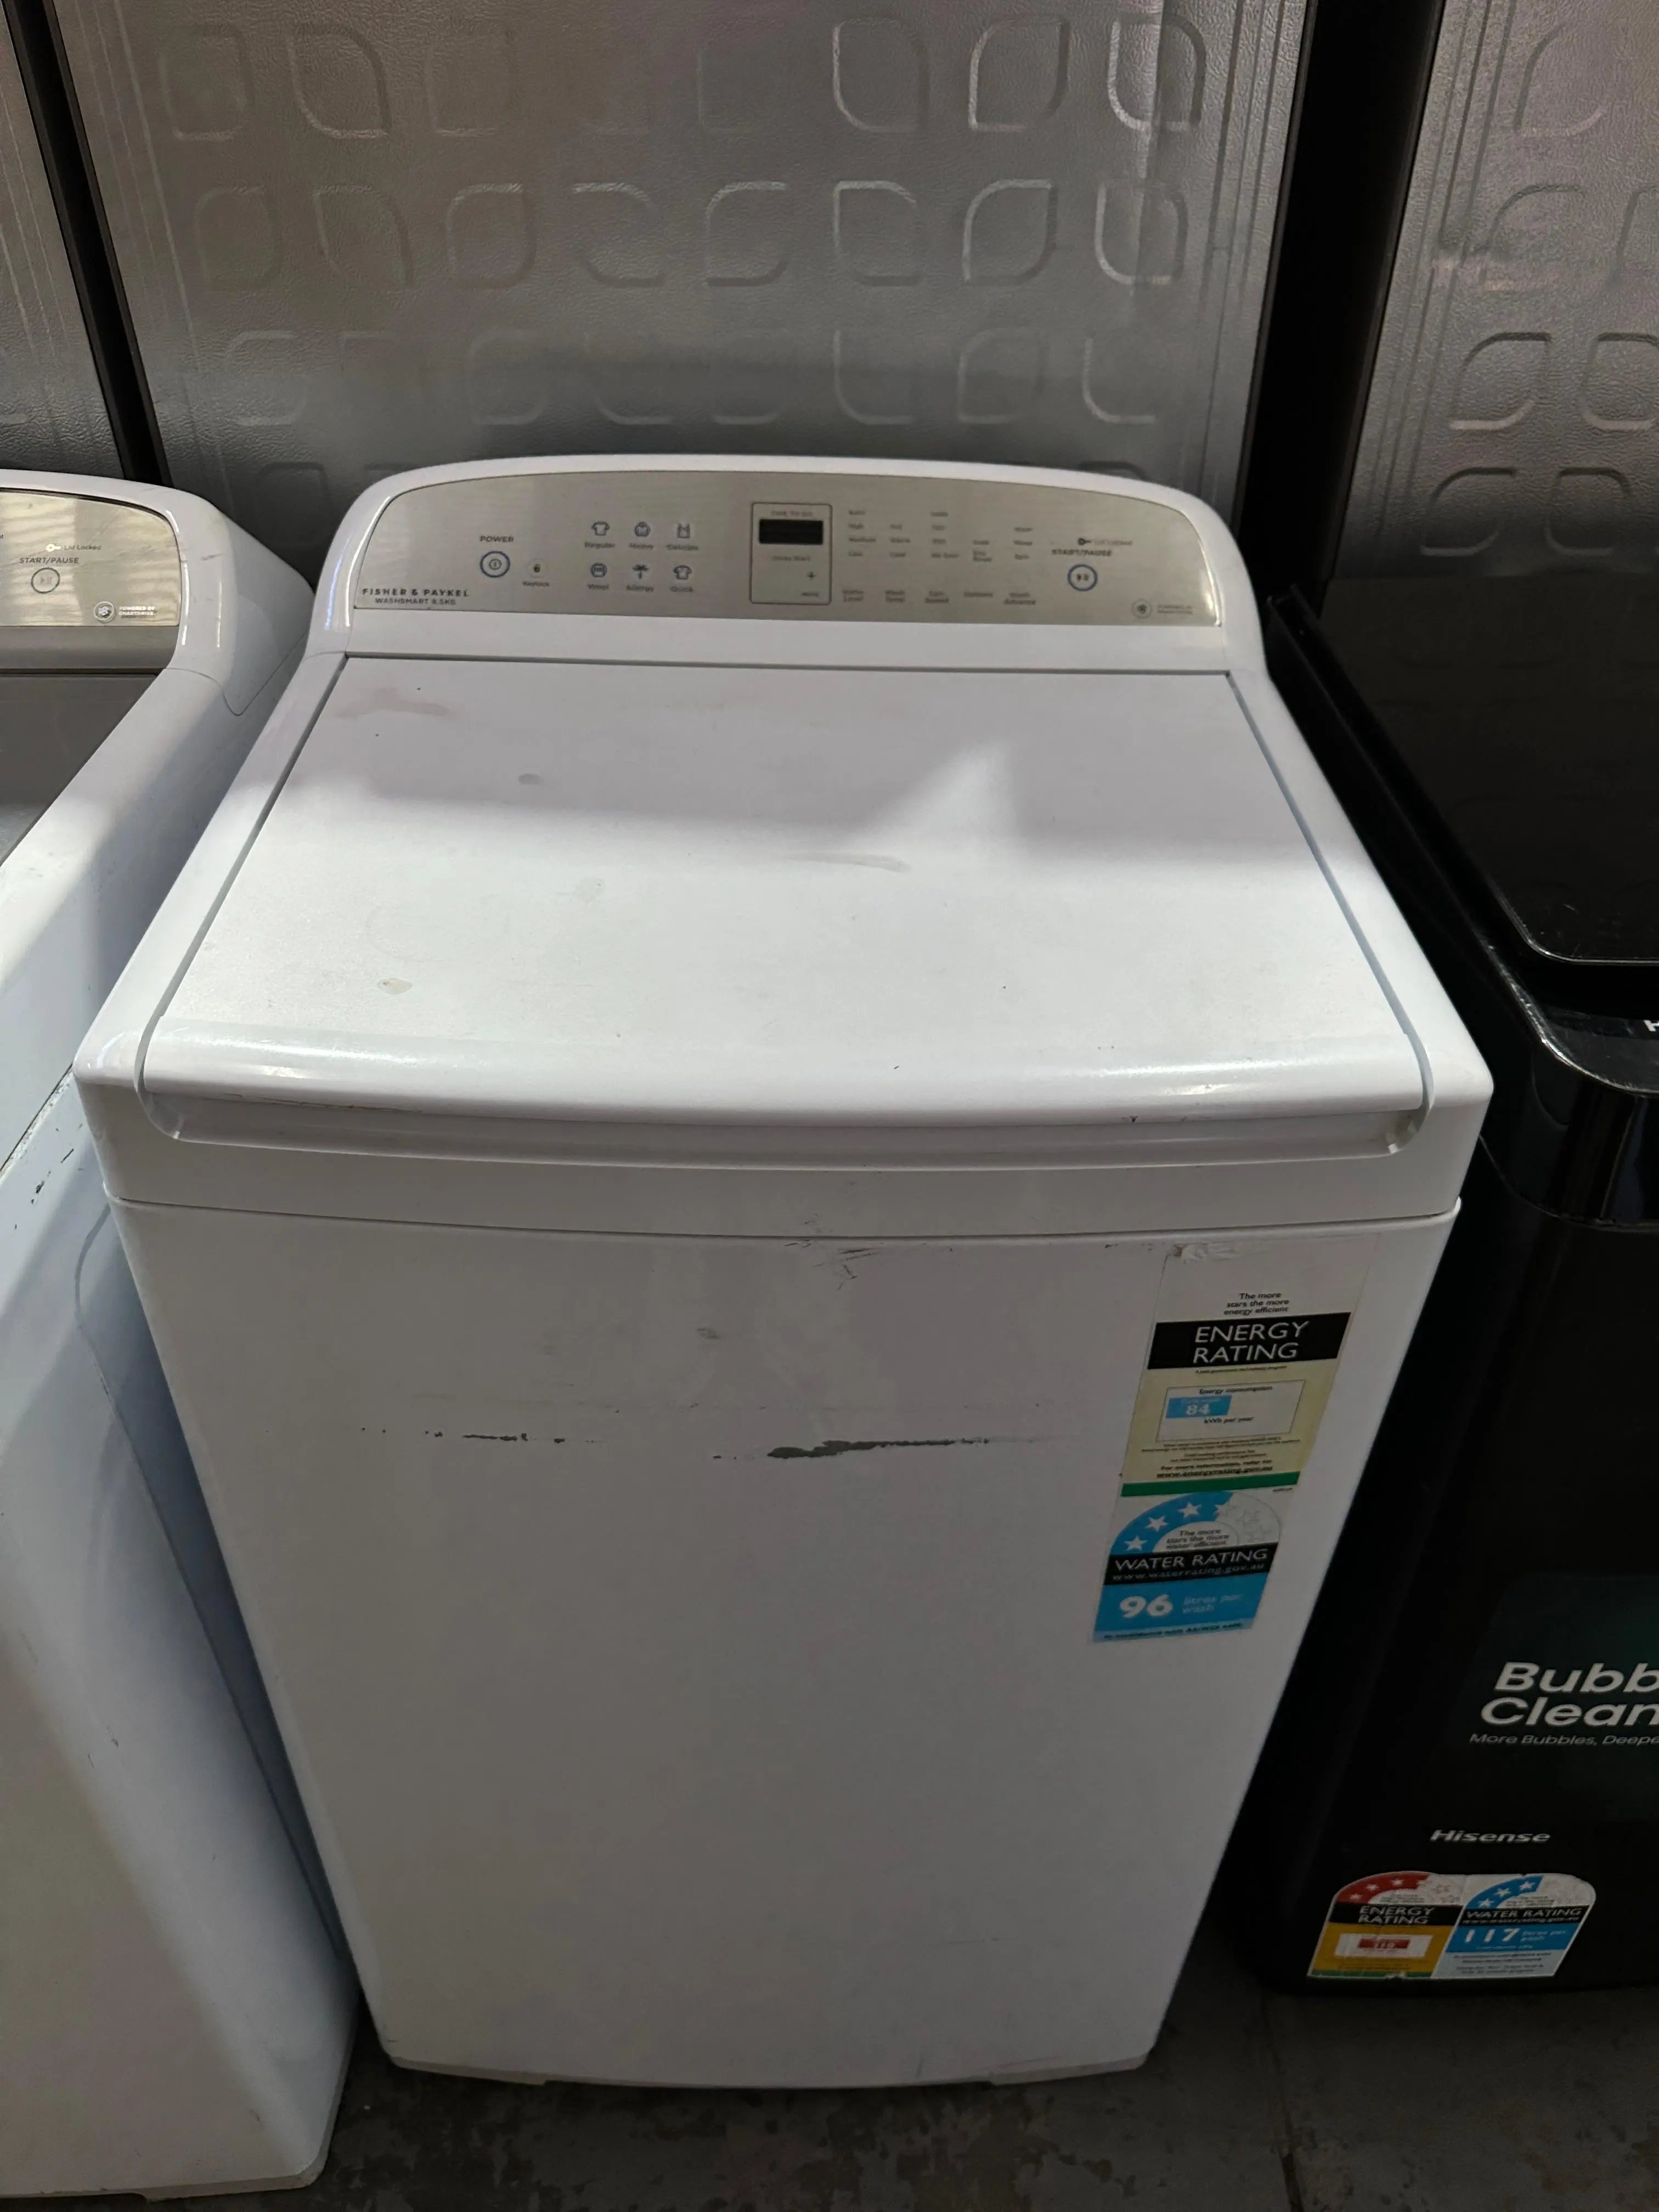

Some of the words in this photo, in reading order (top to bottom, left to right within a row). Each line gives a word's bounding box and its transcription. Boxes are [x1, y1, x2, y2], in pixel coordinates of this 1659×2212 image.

[1194, 1321, 1310, 1344] ENERGY
[1193, 1342, 1299, 1364] RATING
[1185, 1403, 1210, 1415] 84
[1114, 1556, 1186, 1571] WATER
[1191, 1548, 1269, 1567] RATING
[1112, 1563, 1265, 1581] www.waterrating.gov.au
[1119, 1593, 1173, 1619] 96
[1494, 1661, 1659, 1693] Bubb
[1480, 1696, 1659, 1726] Clean
[1469, 1733, 1518, 1745] More
[1521, 1734, 1597, 1746] Bubbles,
[1430, 1829, 1551, 1843] Hisense
[1359, 1905, 1436, 1916] ENERGY
[1466, 1910, 1519, 1918] WATER
[1522, 1908, 1583, 1918] RATING
[1358, 1915, 1430, 1925] RATING
[1464, 1927, 1521, 1943] 117
